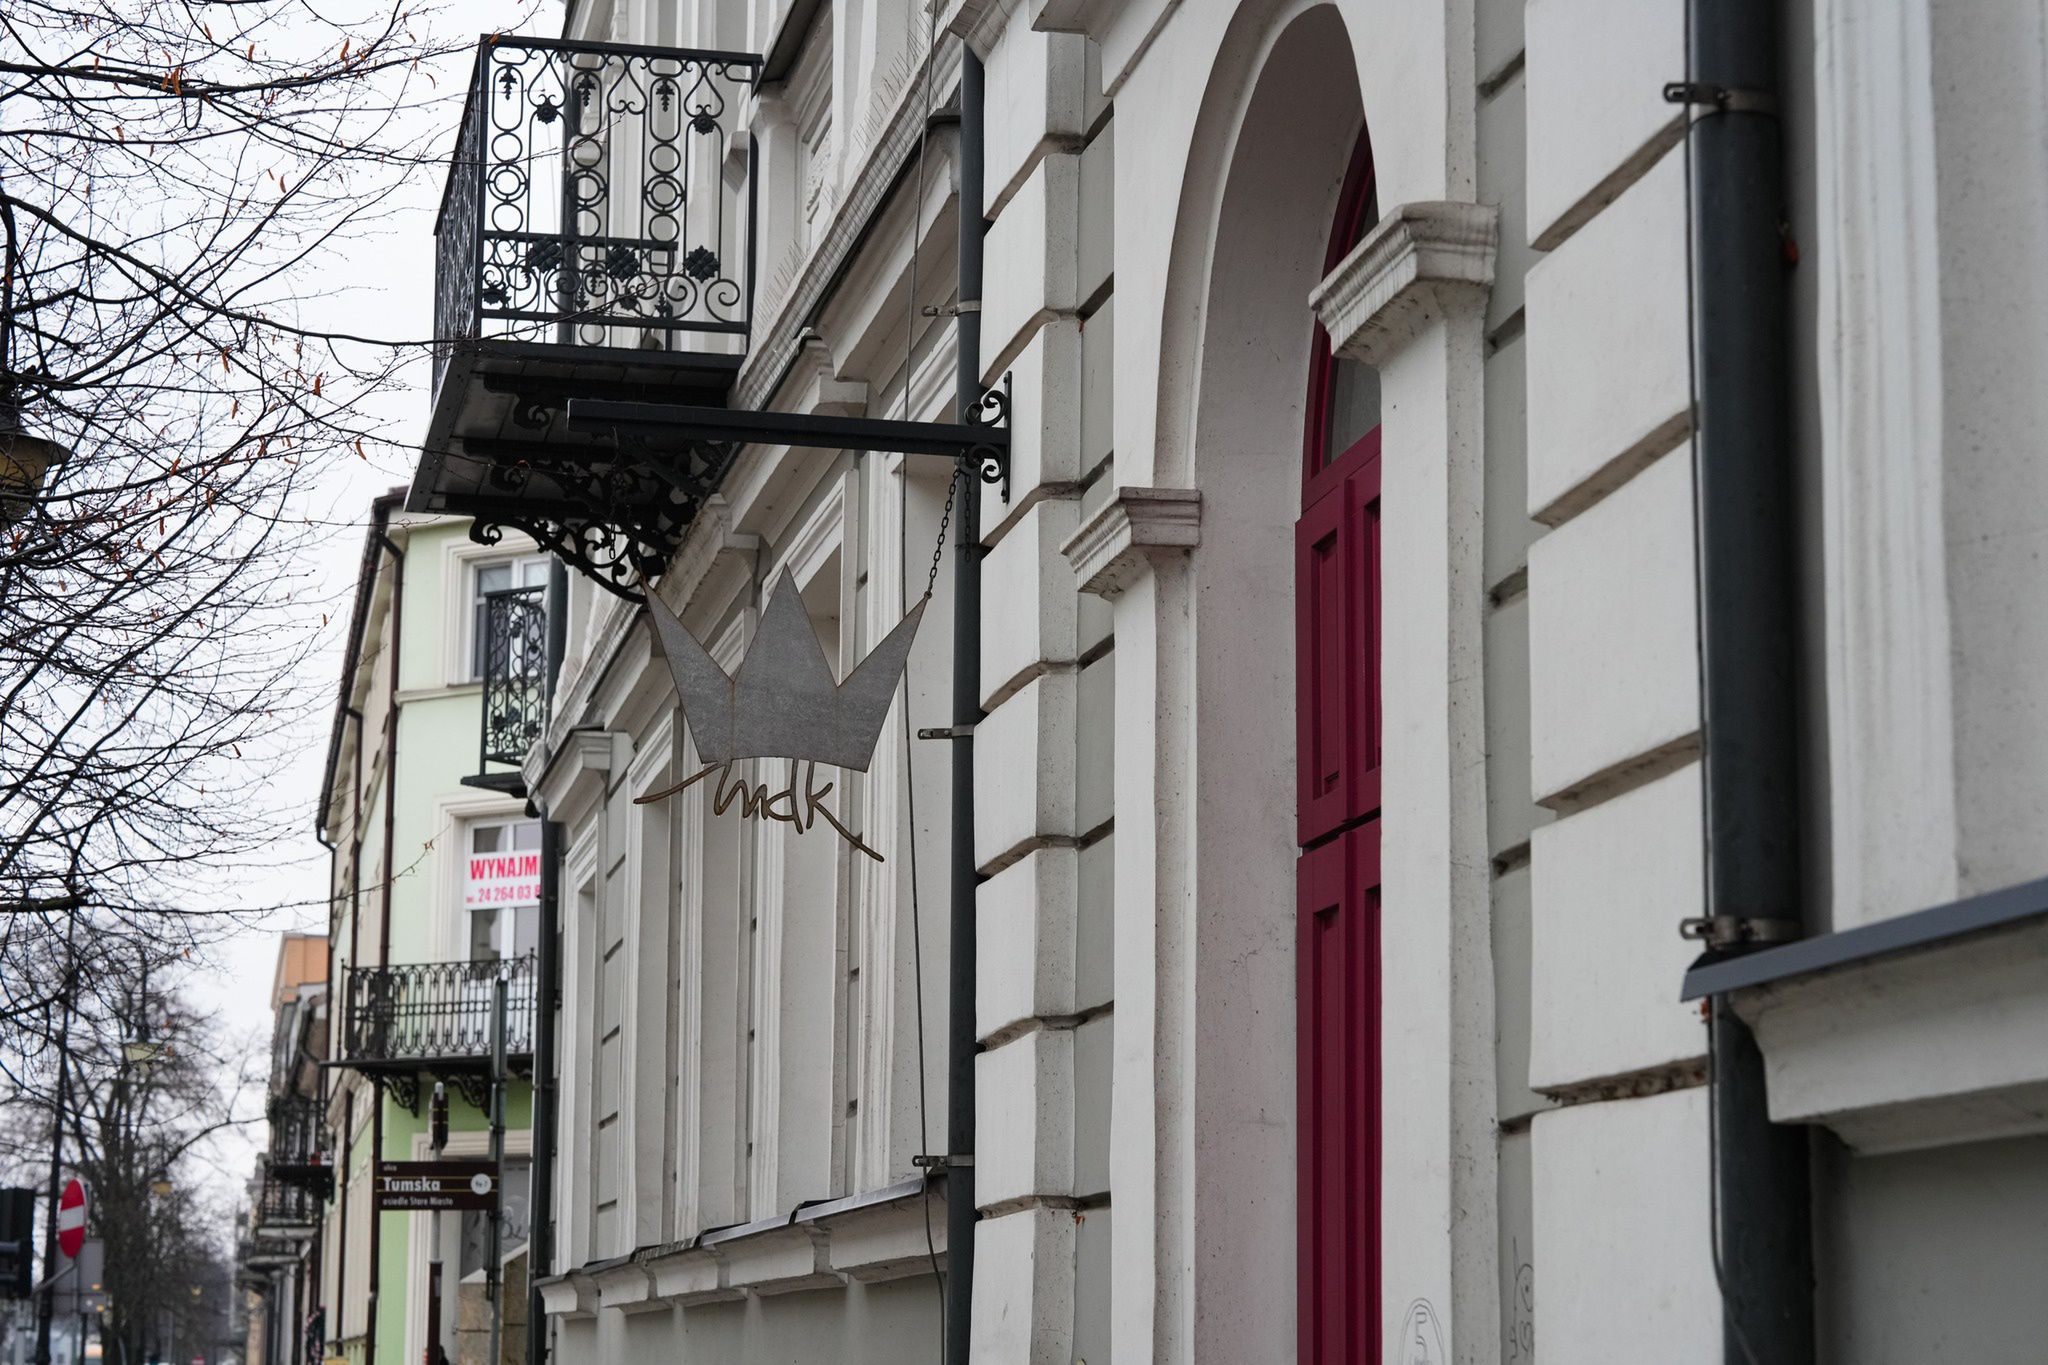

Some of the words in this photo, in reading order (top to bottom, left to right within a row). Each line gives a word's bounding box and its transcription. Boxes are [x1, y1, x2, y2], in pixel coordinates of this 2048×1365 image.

[470, 856, 541, 880] WYNAJM
[479, 888, 491, 902] 24
[494, 886, 514, 901] 264
[517, 885, 531, 899] 03
[383, 1176, 440, 1191] Tumska
[383, 1198, 408, 1206] osiedle
